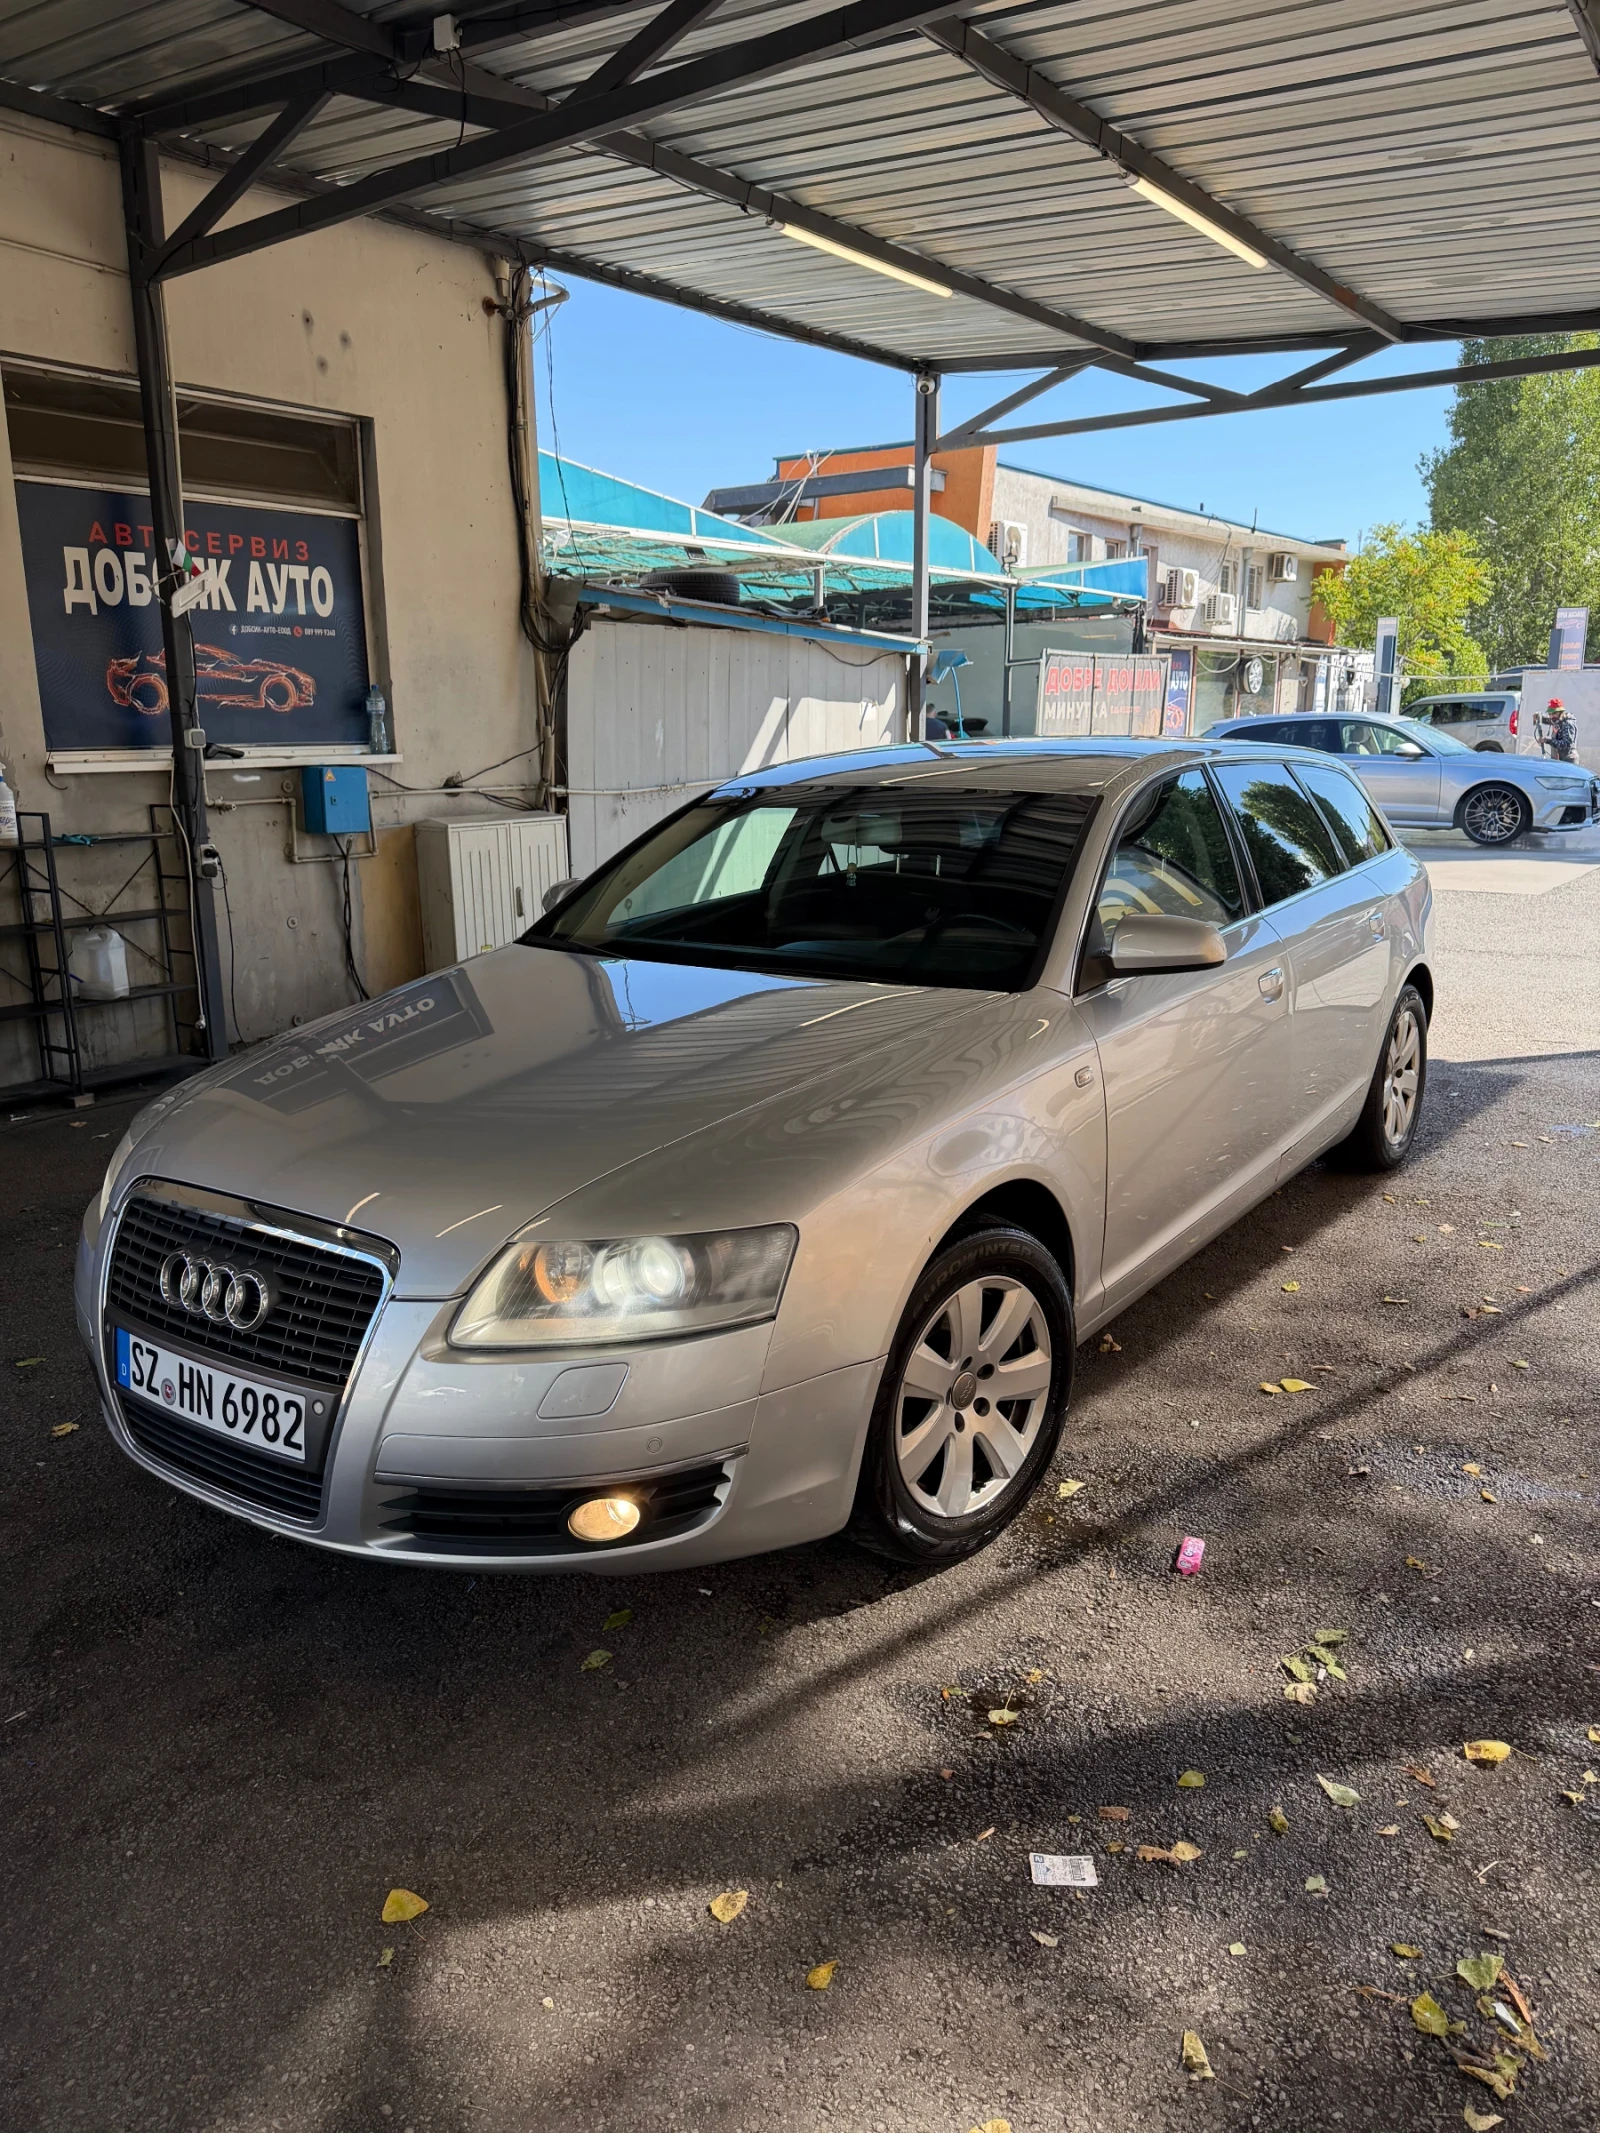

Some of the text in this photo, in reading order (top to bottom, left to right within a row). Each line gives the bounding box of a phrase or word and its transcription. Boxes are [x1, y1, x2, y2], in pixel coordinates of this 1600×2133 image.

[89, 521, 309, 561] АВТСЕРВИЗ
[247, 561, 334, 617] АУТО
[1045, 667, 1162, 695] ДОБРЕ ДОШЛИ
[1044, 701, 1107, 720] МИНУТКА
[122, 1363, 127, 1376] D
[132, 1341, 303, 1451] SZ HN 6982
